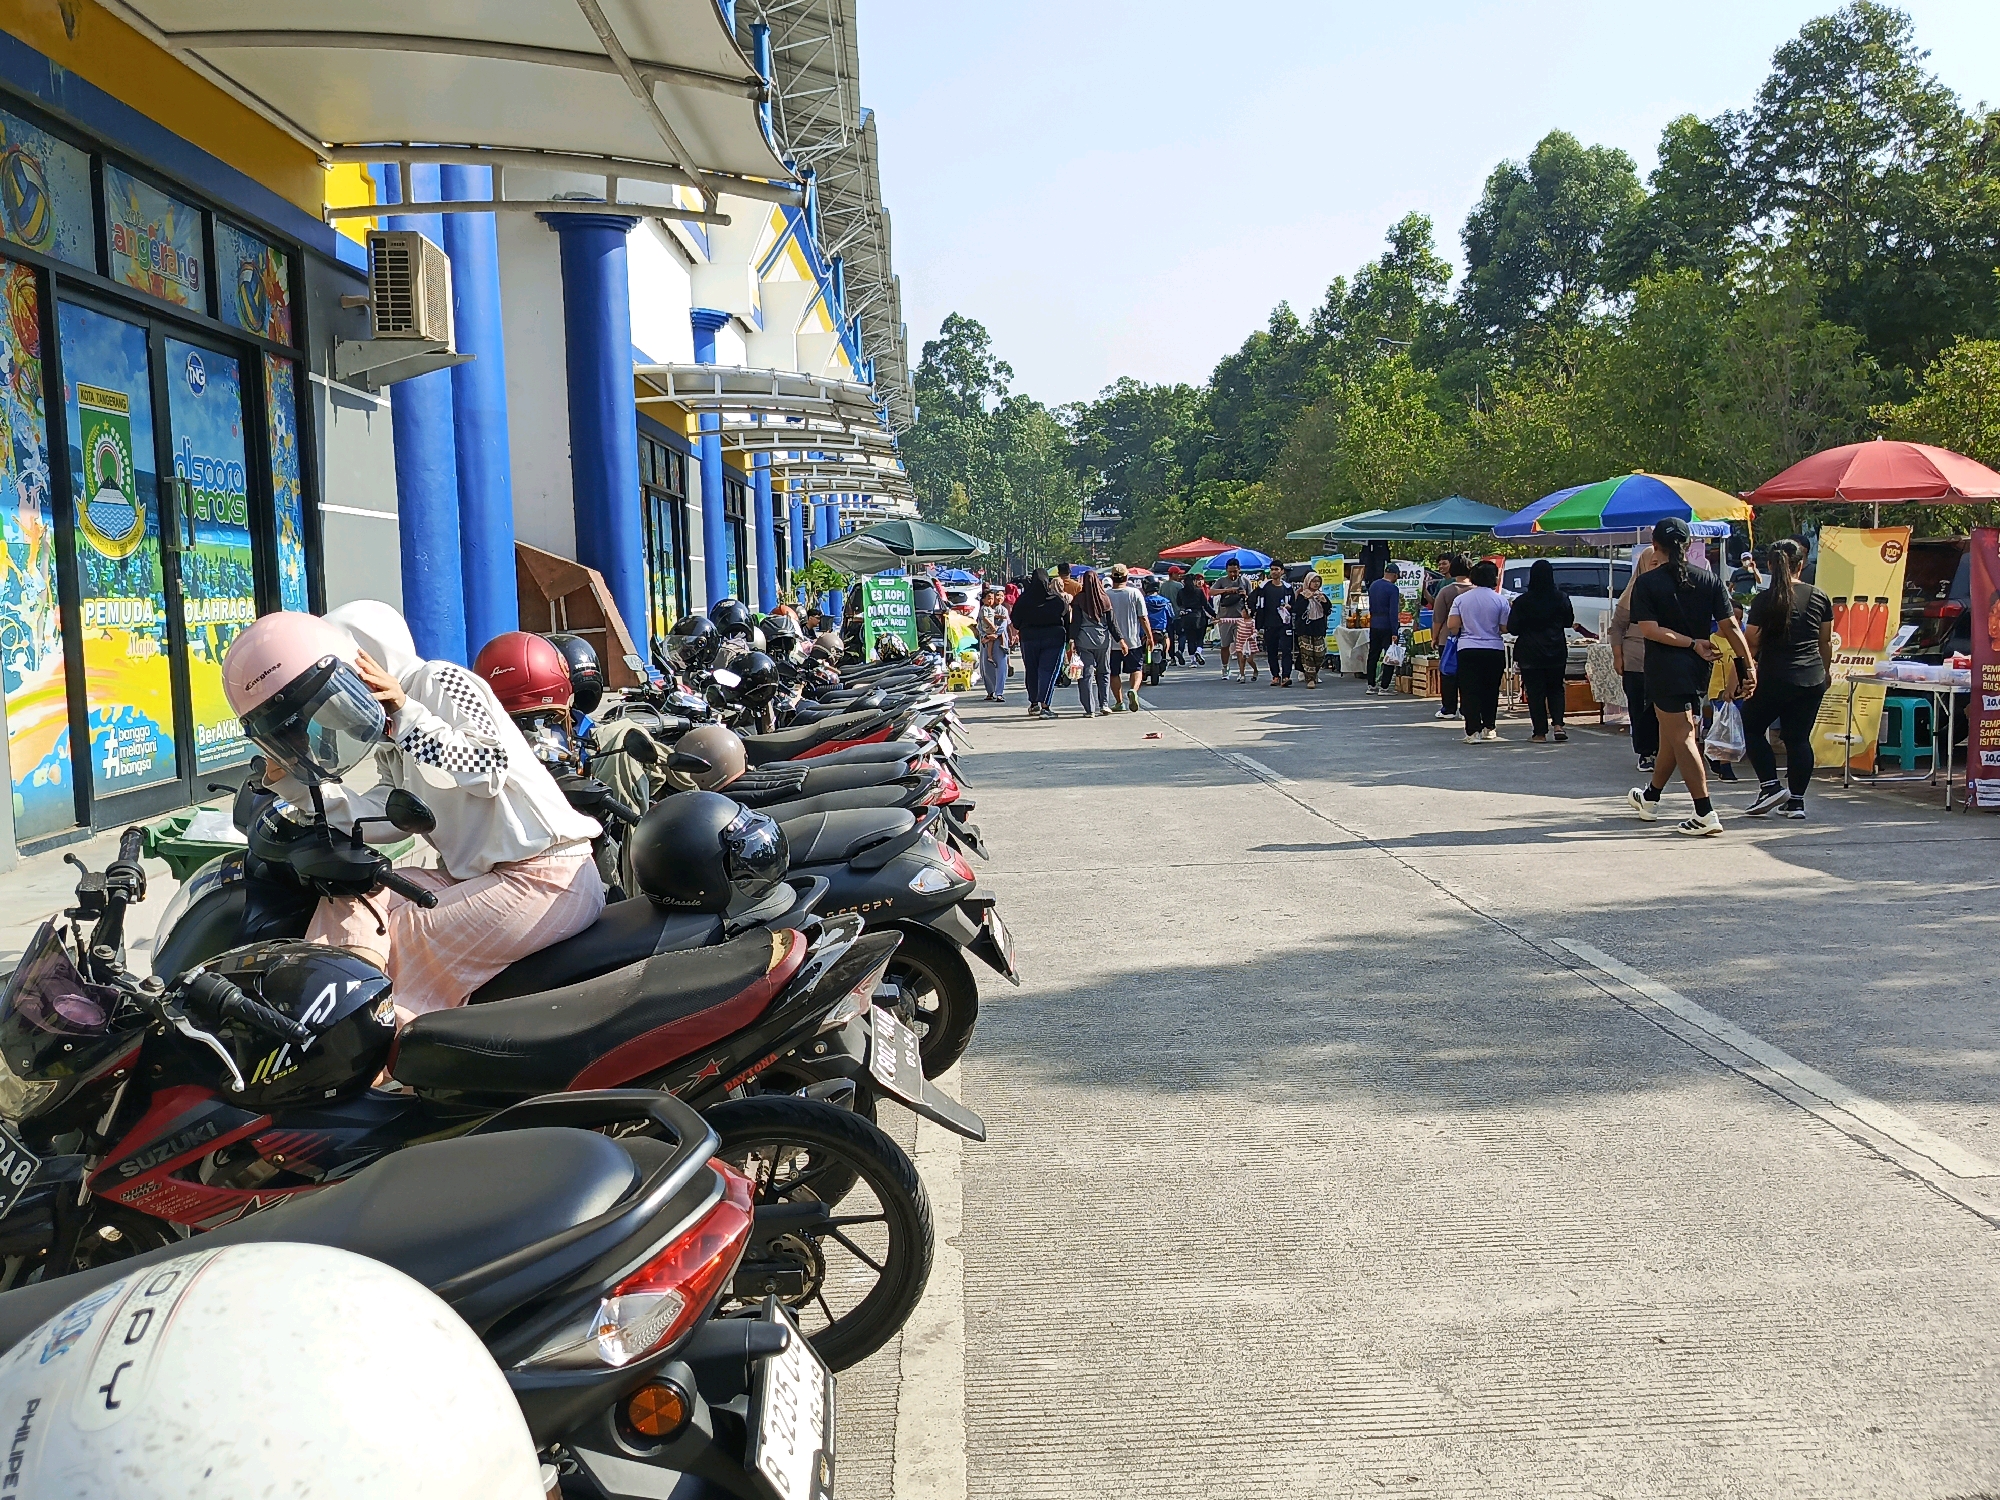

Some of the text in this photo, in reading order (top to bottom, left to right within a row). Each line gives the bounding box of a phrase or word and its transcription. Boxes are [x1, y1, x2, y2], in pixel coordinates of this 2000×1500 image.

[80, 388, 127, 410] KOTA TANGERANG
[871, 589, 906, 602] ES KOPI
[85, 599, 255, 626] PEMUDA OLAHRAGA
[867, 604, 912, 618] MATCHA
[871, 618, 907, 628] GULA AREN
[1831, 653, 1875, 666] Jamu
[1983, 681, 2000, 691] BIAS
[118, 725, 151, 742] bangga
[198, 717, 246, 746] BerAKHL
[119, 737, 158, 758] melayani
[120, 758, 152, 776] bangsa
[662, 896, 702, 907] Classic
[724, 1052, 779, 1092] DAYTONA
[119, 1121, 218, 1178] SUZUKI
[771, 1370, 798, 1456] 3235
[765, 1455, 791, 1495] B
